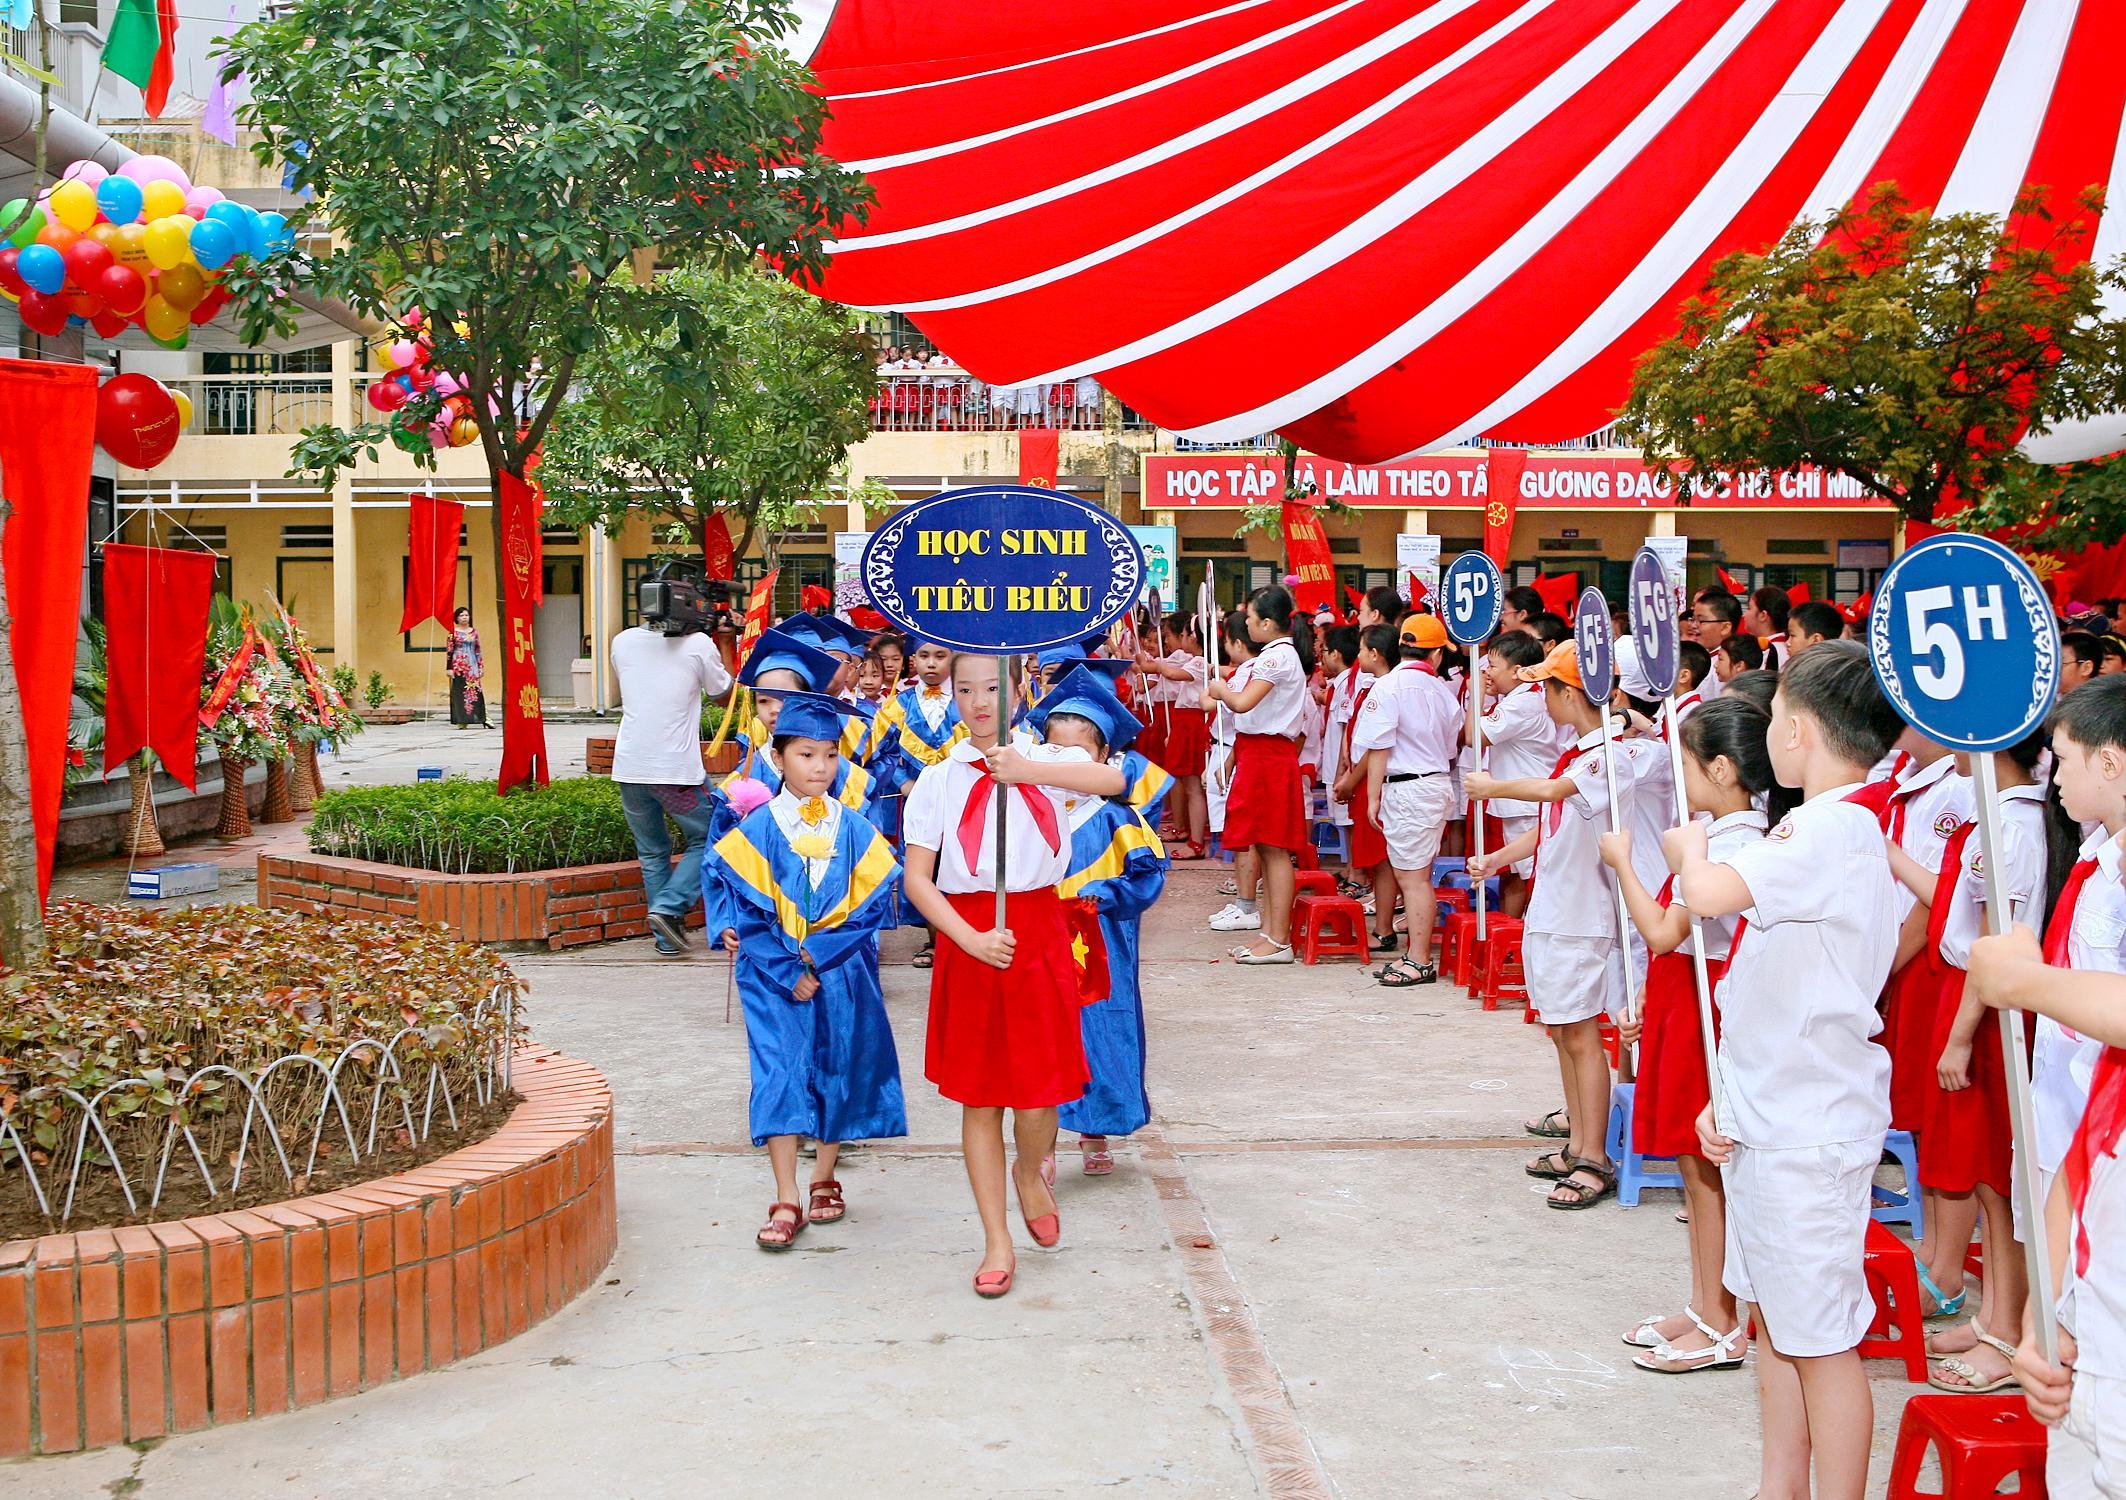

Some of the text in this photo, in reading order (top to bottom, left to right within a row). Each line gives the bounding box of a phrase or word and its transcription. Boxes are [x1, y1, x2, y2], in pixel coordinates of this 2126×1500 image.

[1167, 470, 1219, 504] HỌC
[1226, 463, 1276, 504] TẬP
[1326, 463, 1378, 496] LÀM
[1386, 470, 1451, 497] THEO
[1456, 460, 1488, 497] TẤ
[1520, 468, 1610, 499] GƯƠNG
[1779, 465, 1822, 498] CHÍ
[917, 529, 1088, 564] HỌC SINH
[912, 571, 1092, 611] TIÊU BIỂU
[1455, 572, 1488, 622] 5D
[1582, 614, 1603, 676] 5E
[1638, 581, 1667, 659] 5G
[1905, 585, 2008, 701] 5H
